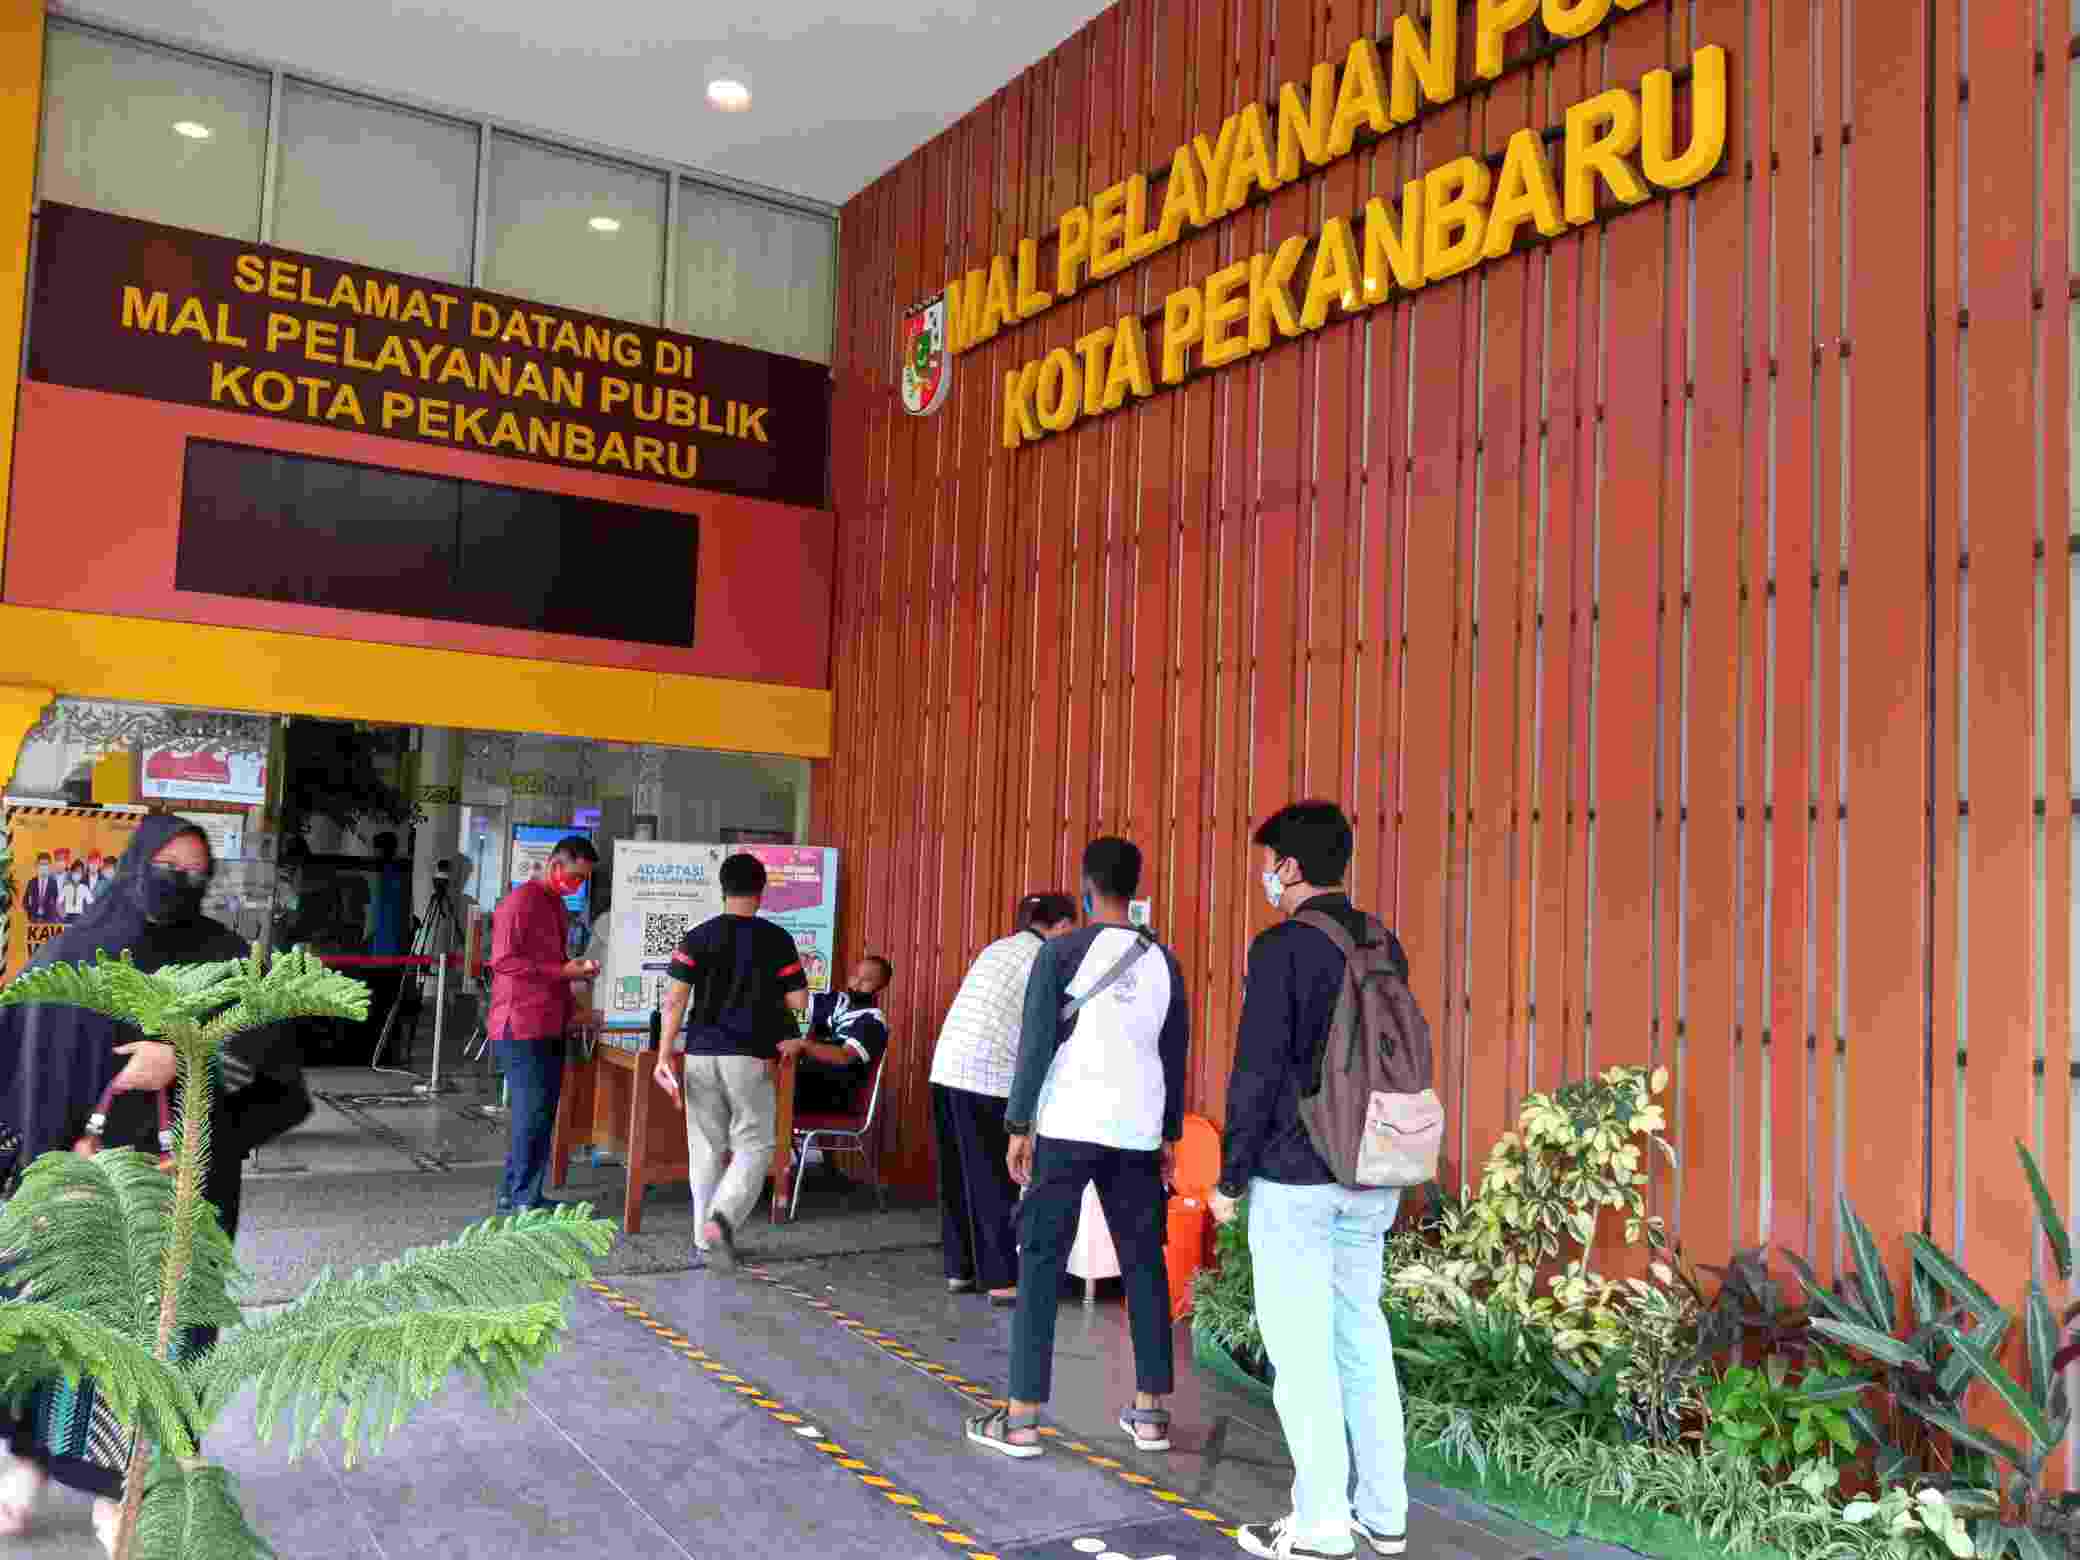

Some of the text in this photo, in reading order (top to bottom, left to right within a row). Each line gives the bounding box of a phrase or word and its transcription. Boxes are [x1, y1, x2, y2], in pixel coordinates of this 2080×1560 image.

[945, 238, 1053, 354] MAL
[1055, 0, 1457, 298] PELAYANAN
[1001, 43, 1727, 449] KOTA PEKANBARU
[121, 286, 770, 444] MAL PELAYANAN PUBLIK
[235, 254, 693, 380] SELAMAT DATANG DI
[210, 364, 698, 479] KOTA PEKANBARU
[636, 863, 704, 877] ADAPTASI
